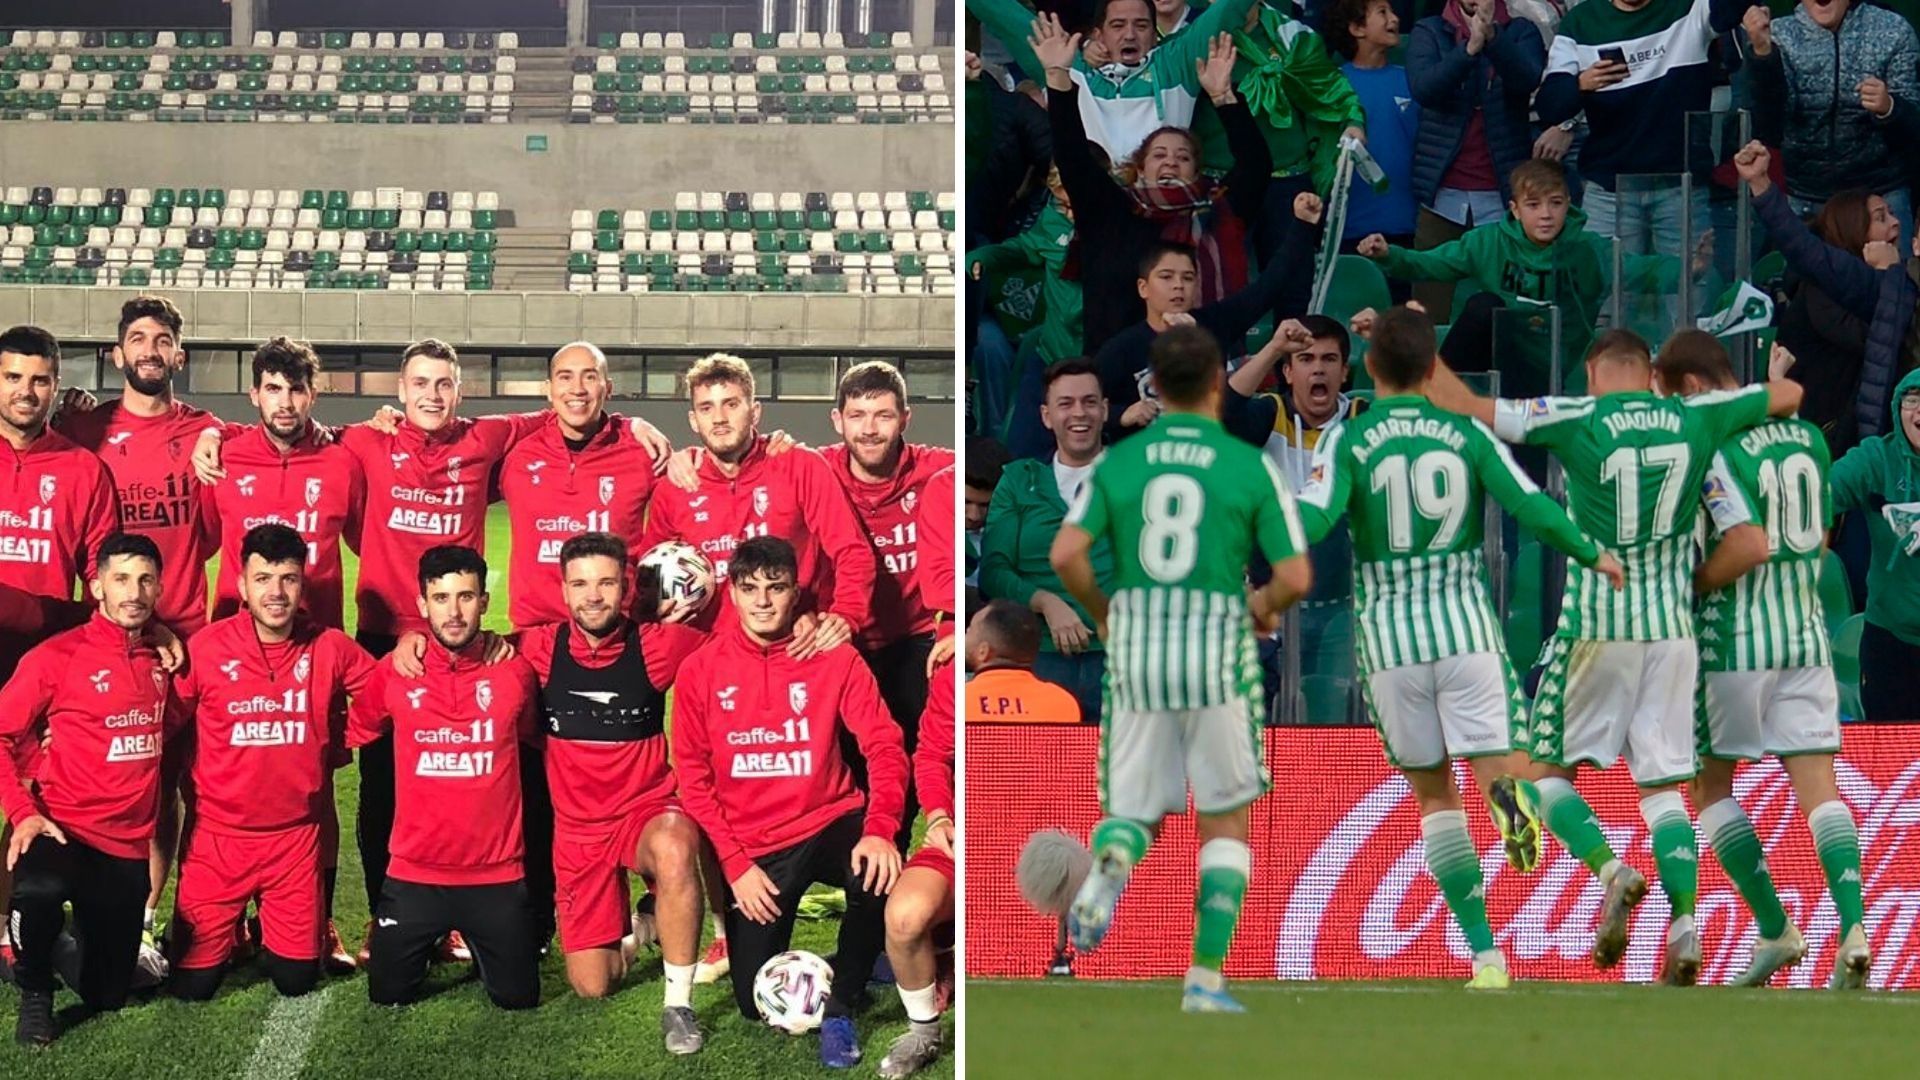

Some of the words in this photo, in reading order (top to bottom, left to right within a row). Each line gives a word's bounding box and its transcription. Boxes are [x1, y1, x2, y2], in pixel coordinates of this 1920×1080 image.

[1740, 423, 1811, 456] CANALES
[1145, 440, 1217, 470] FEKIR
[1370, 450, 1470, 552] 19
[1600, 442, 1690, 545] 17
[1757, 452, 1824, 555] 10
[123, 500, 190, 528] REA11
[387, 507, 462, 535] AREA11
[1138, 472, 1206, 585] 8
[0, 535, 51, 563] EA11
[979, 696, 1029, 714] E.P.I.
[229, 720, 306, 746] AREA11
[549, 716, 560, 732] 3
[415, 751, 494, 777] AREA11
[730, 750, 812, 778] AREA11
